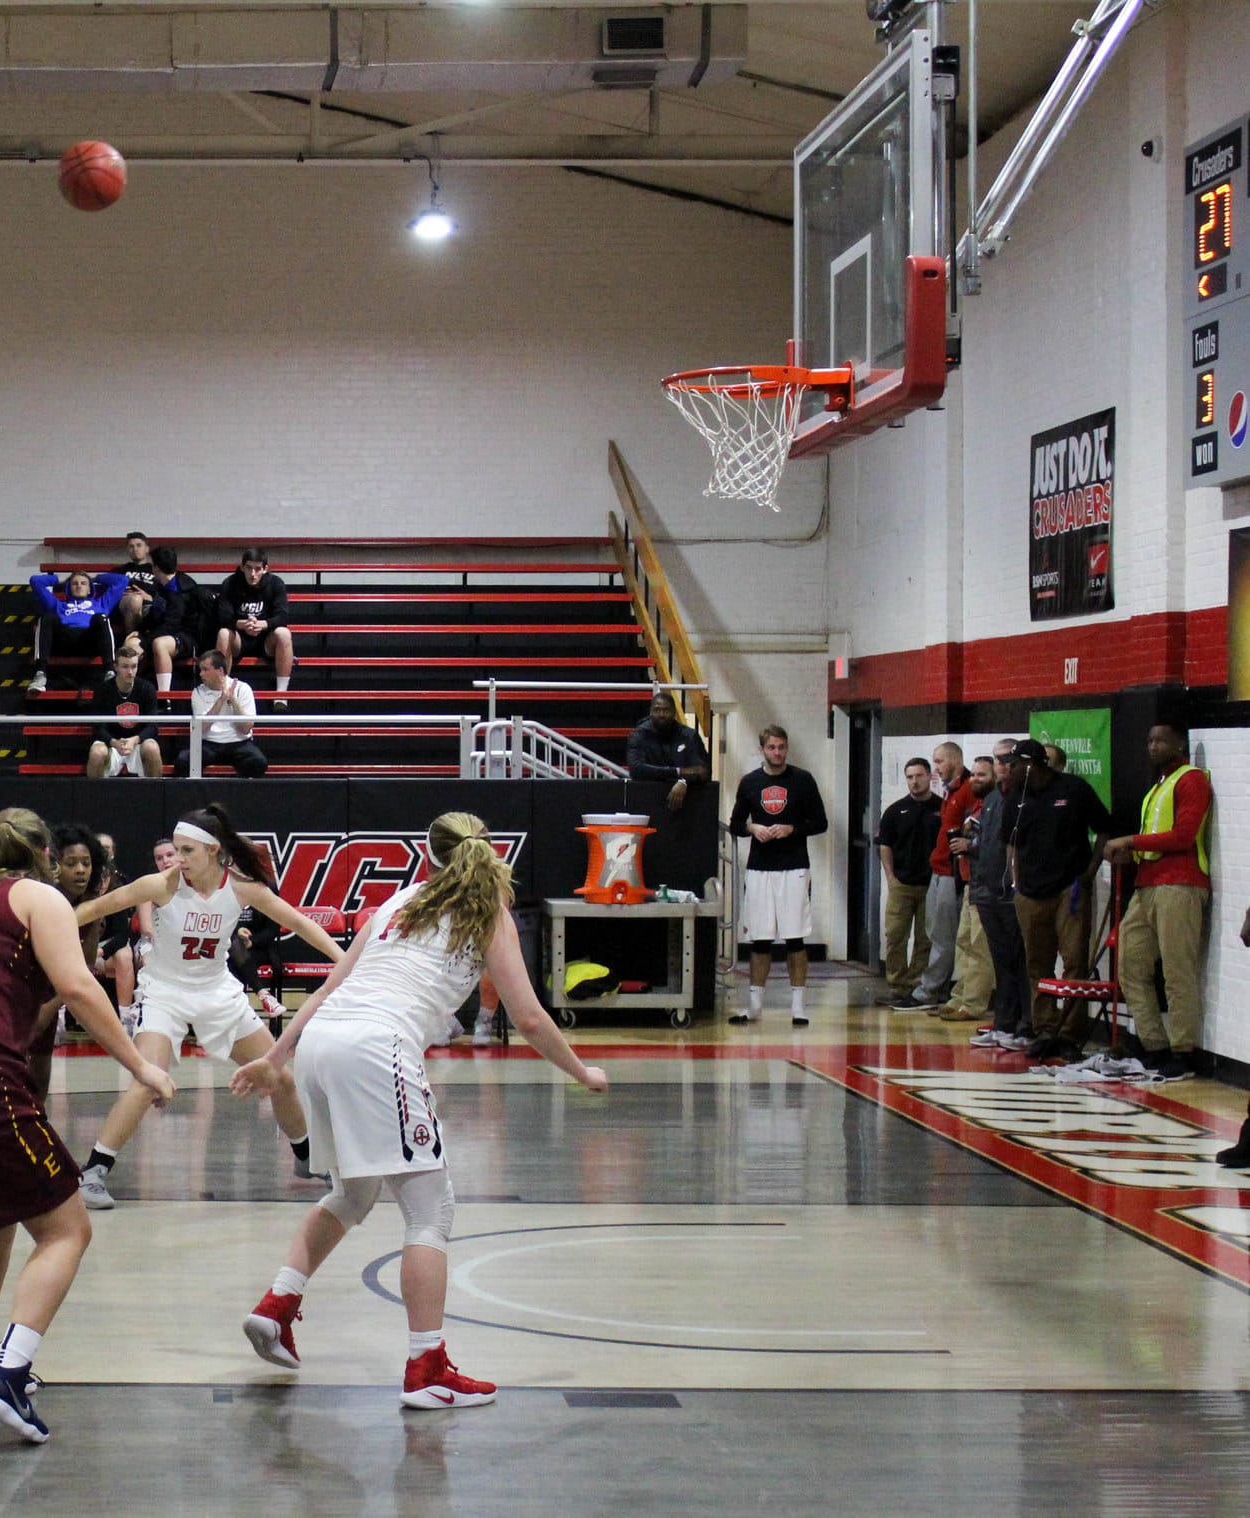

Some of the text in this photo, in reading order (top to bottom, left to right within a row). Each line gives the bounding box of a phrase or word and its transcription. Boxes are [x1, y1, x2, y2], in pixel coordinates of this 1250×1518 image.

[1191, 145, 1234, 188] Crusaders
[1198, 183, 1232, 262] 27
[1201, 373, 1215, 424] 3
[1033, 424, 1113, 498] JUST DO IT.
[1195, 441, 1214, 467] won
[1033, 479, 1113, 540] CRUSADERS
[1064, 657, 1079, 685] EXIT
[182, 911, 223, 933] NGU
[180, 936, 220, 961] 25
[43, 1152, 62, 1178] E
